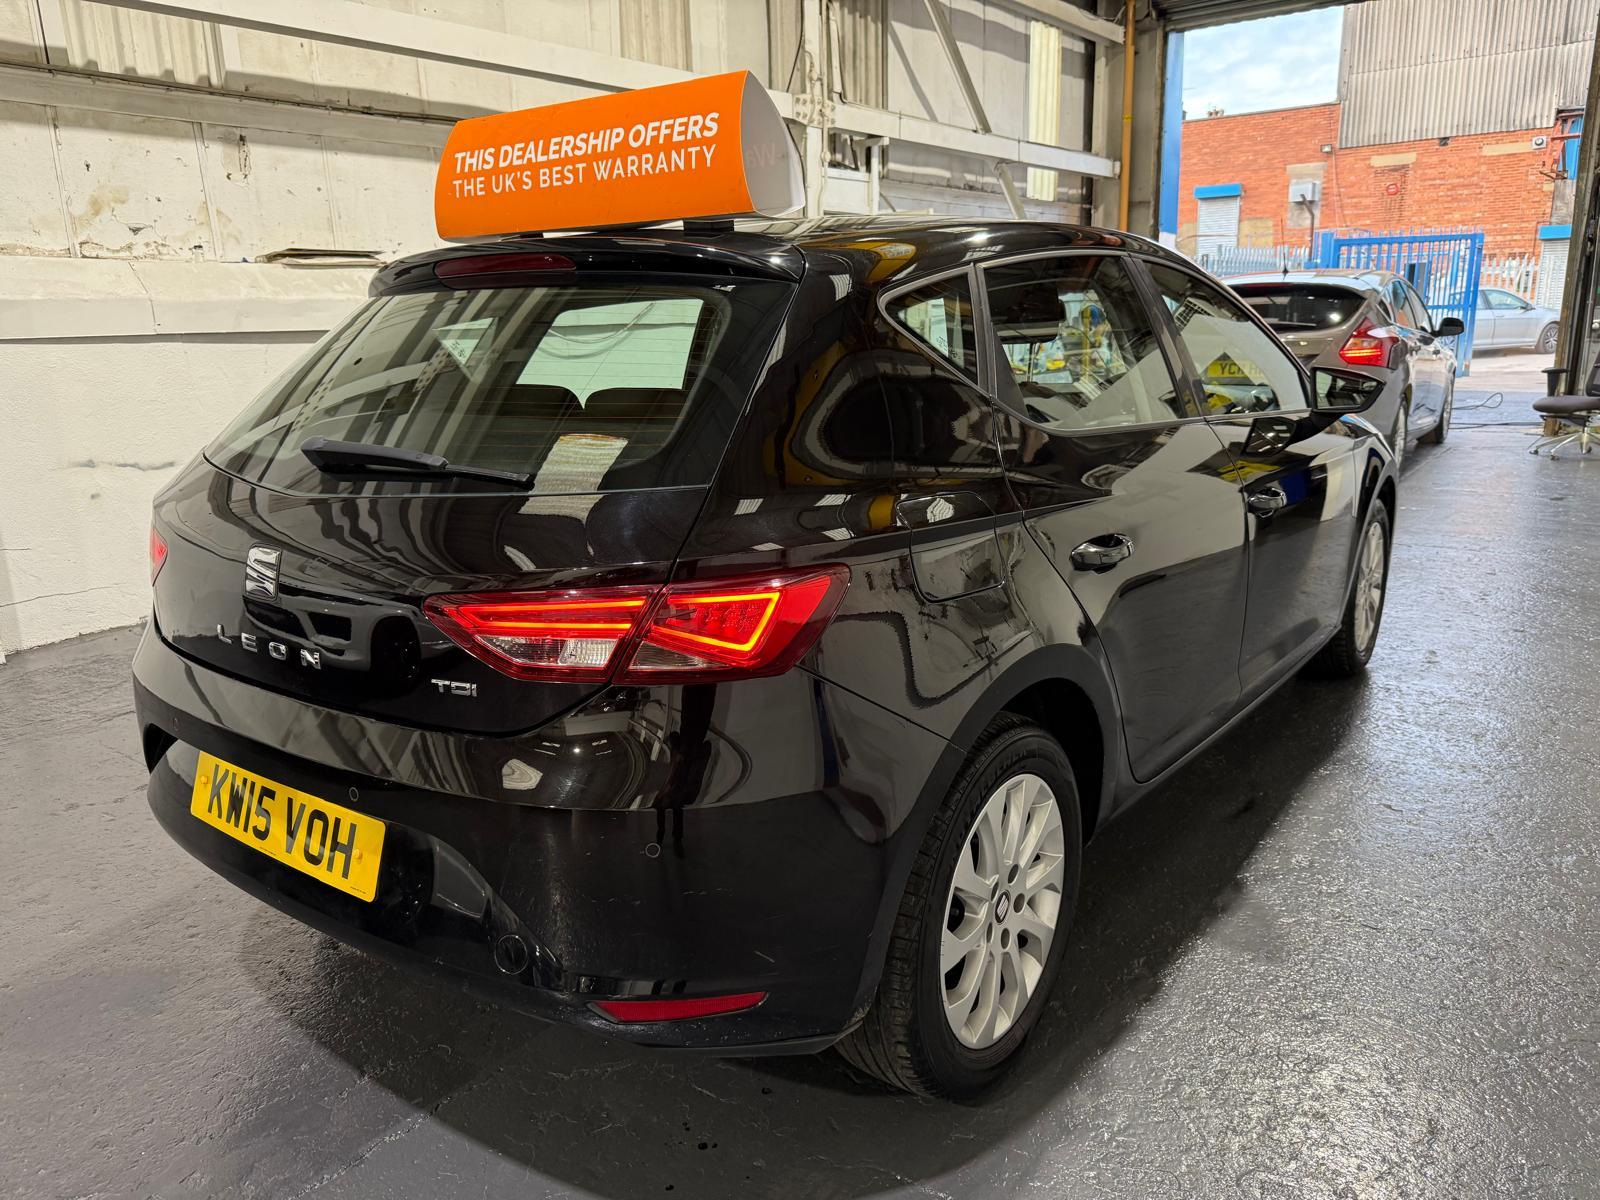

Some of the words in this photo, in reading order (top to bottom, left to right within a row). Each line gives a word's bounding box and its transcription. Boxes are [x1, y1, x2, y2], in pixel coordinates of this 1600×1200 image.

[454, 147, 496, 174] THIS
[499, 127, 625, 168] DEALERSHIP
[628, 112, 720, 148] OFFERS
[452, 177, 485, 199] THE
[492, 171, 532, 194] UK'S
[539, 163, 587, 189] BEST
[593, 144, 717, 181] WARRANTY
[216, 624, 321, 670] LEON
[431, 679, 478, 697] TDI
[207, 764, 277, 841] KW15
[285, 797, 358, 880] VOH
